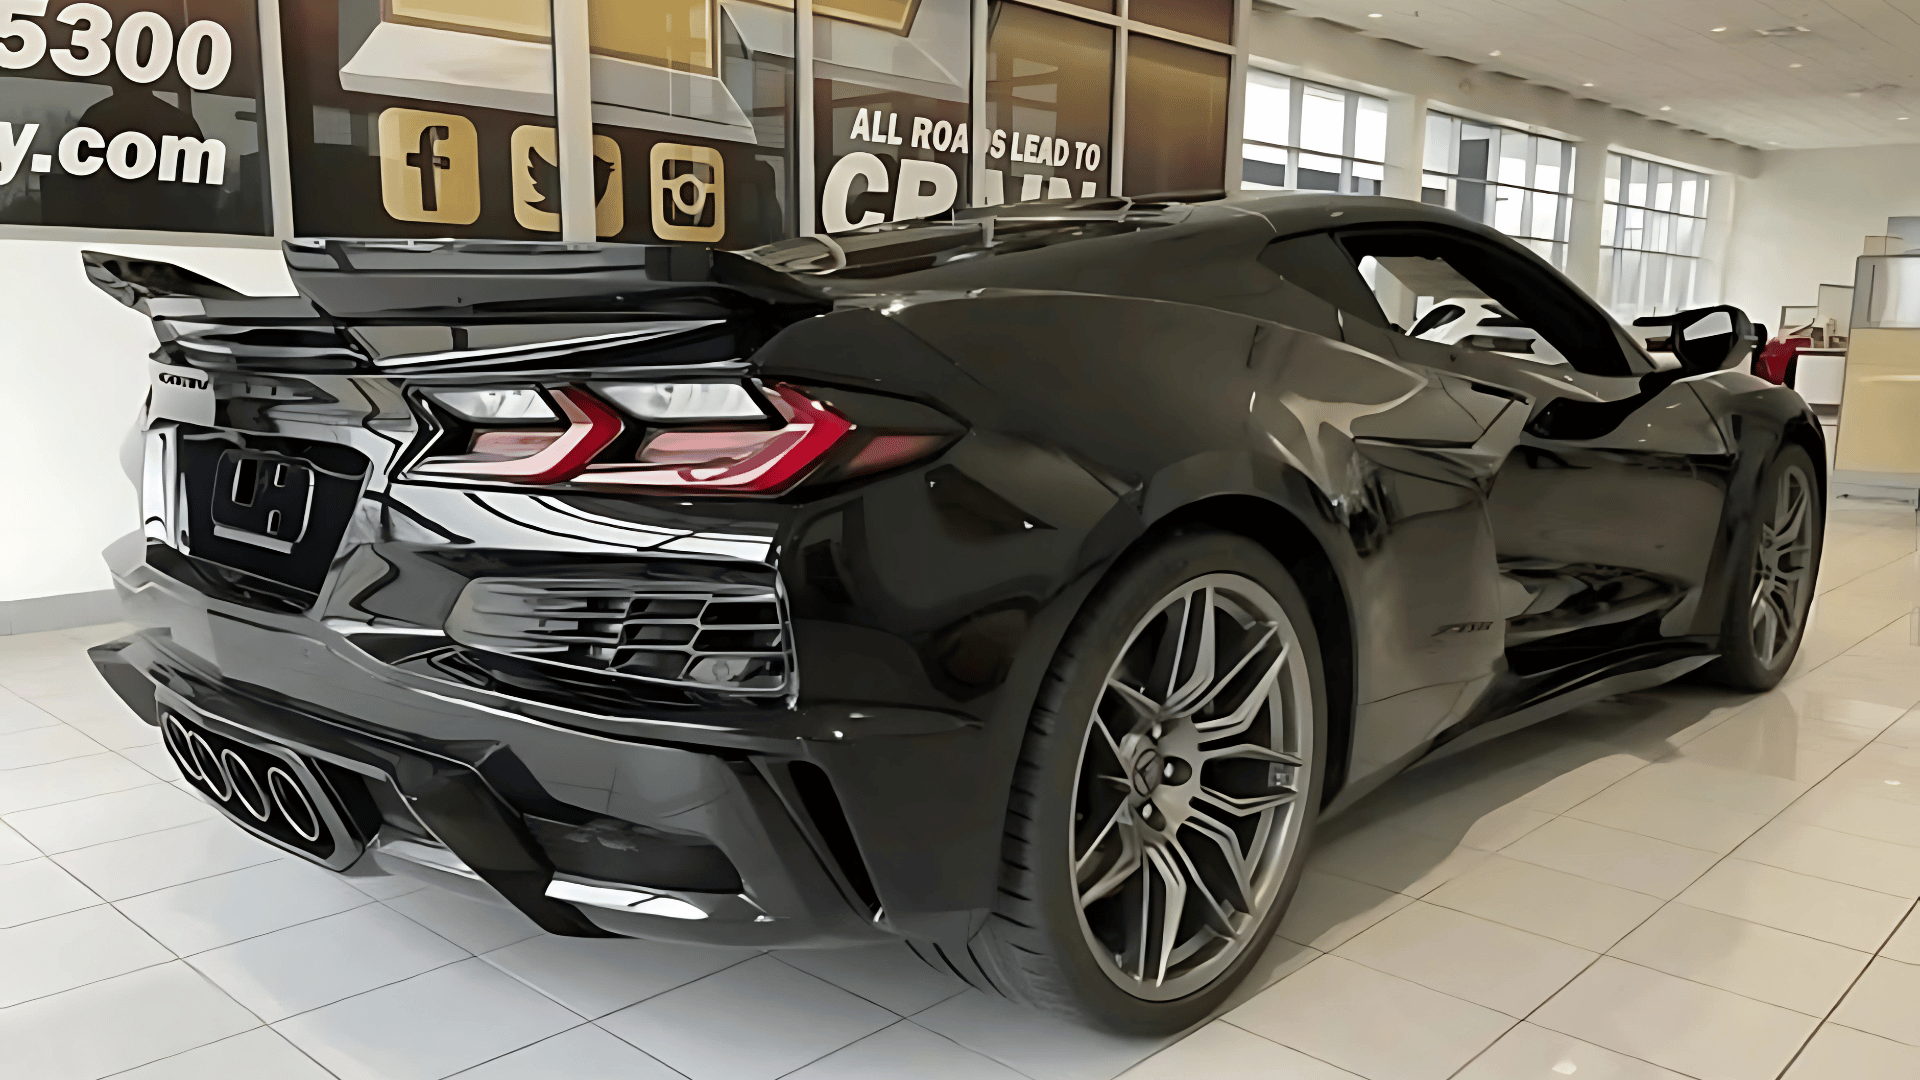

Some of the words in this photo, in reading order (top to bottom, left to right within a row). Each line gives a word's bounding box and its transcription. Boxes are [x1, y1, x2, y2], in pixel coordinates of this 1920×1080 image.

[0, 2, 232, 90] 5300
[0, 121, 227, 185] y.com
[850, 108, 902, 145] ALL
[911, 117, 1006, 158] ROAS
[1011, 132, 1069, 166] LEAD
[1075, 142, 1101, 171] TO
